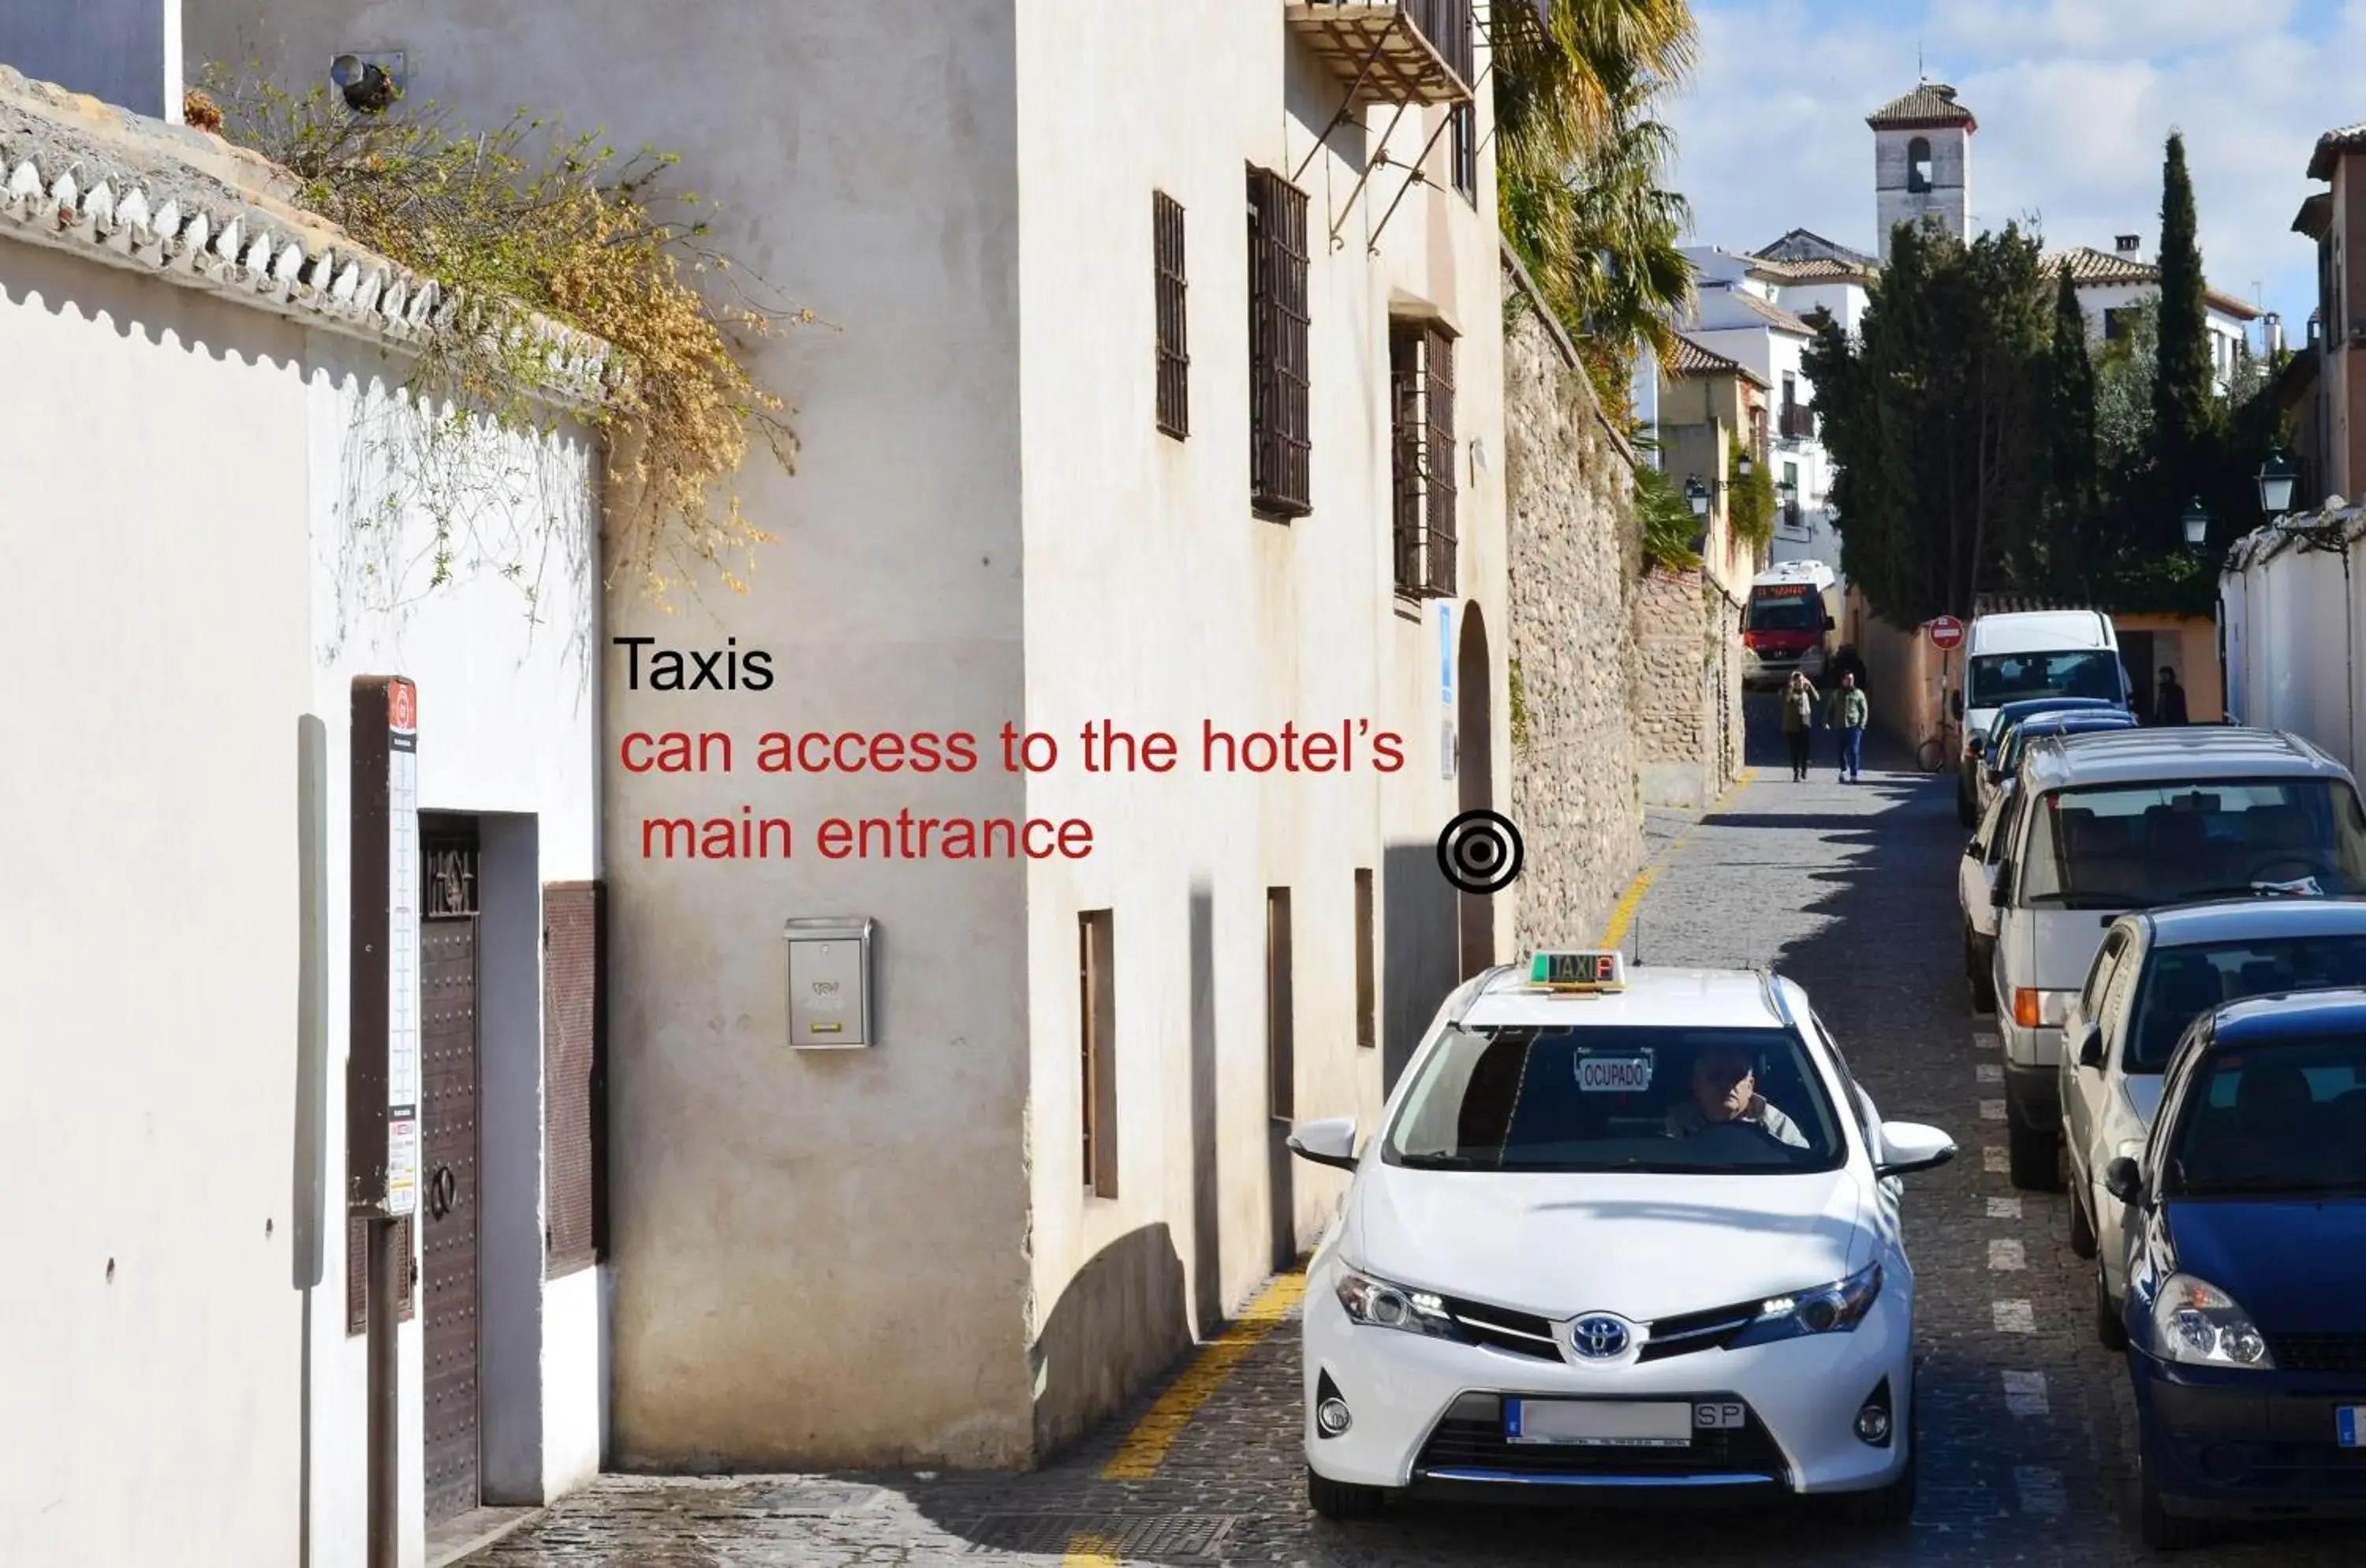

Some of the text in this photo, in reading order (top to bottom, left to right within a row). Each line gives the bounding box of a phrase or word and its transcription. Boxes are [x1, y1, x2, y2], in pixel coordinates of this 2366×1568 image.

[1552, 955, 1594, 978] TAXI
[1584, 1063, 1644, 1086] OCUPADO
[1698, 1405, 1740, 1426] SP
